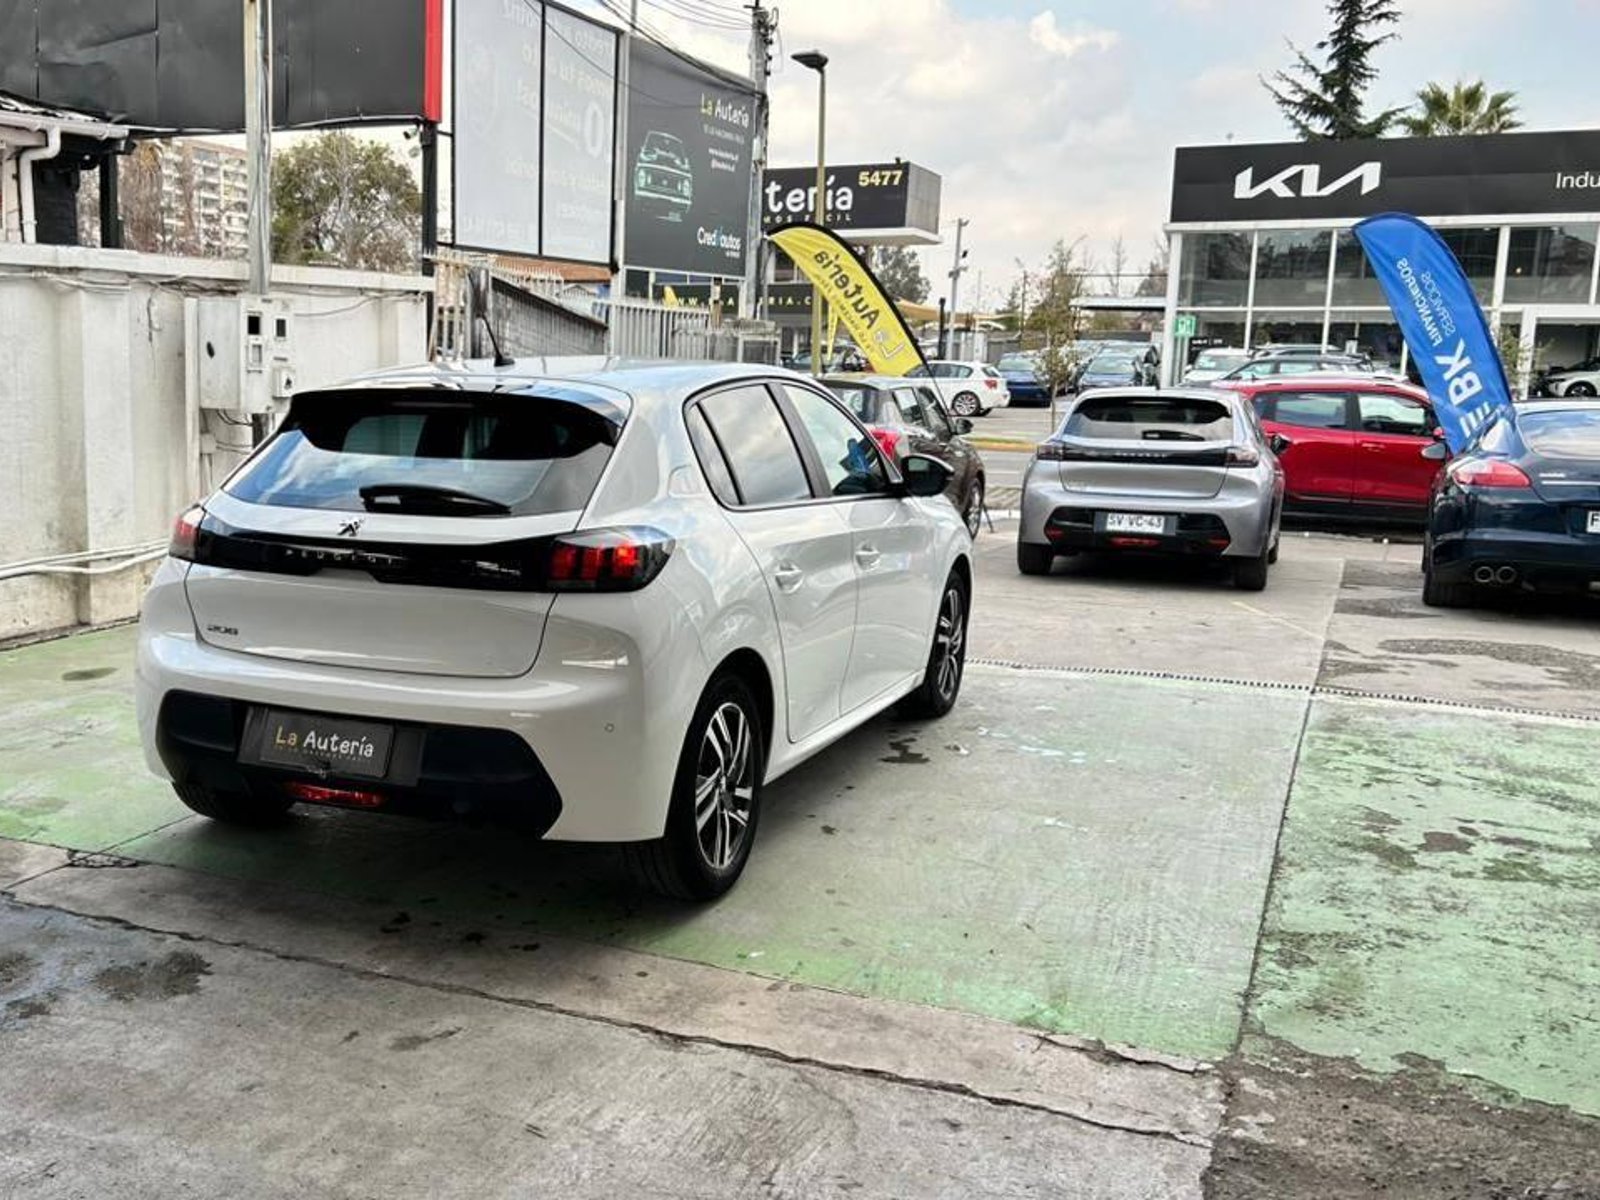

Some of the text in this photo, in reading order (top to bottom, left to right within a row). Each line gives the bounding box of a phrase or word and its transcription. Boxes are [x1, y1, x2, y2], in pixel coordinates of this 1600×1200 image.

[700, 92, 713, 116] La
[858, 170, 903, 188] 5477
[1233, 161, 1382, 199] KIA
[1555, 171, 1600, 190] Indu
[804, 213, 853, 223] FCIL
[275, 725, 298, 747] La
[303, 730, 375, 758] Autería
